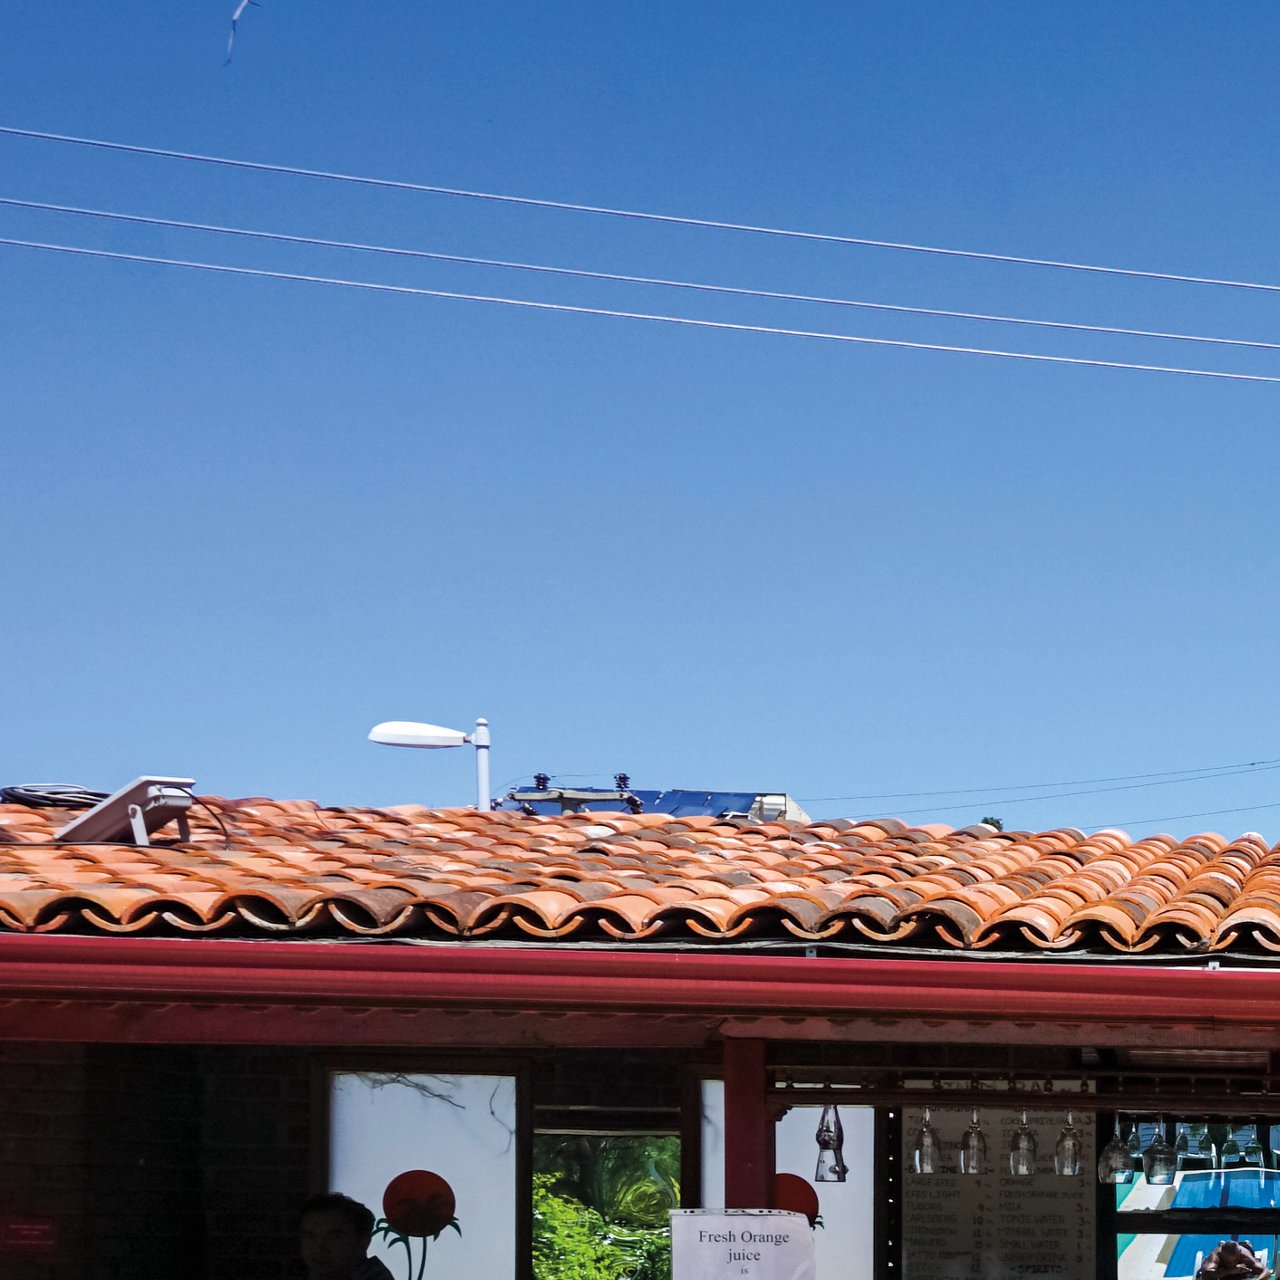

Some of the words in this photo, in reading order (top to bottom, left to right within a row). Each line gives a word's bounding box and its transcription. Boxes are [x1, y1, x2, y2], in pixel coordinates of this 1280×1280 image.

[699, 1230, 736, 1243] Fresh
[740, 1230, 789, 1246] Orange
[726, 1248, 761, 1264] juice
[740, 1266, 749, 1275] is
